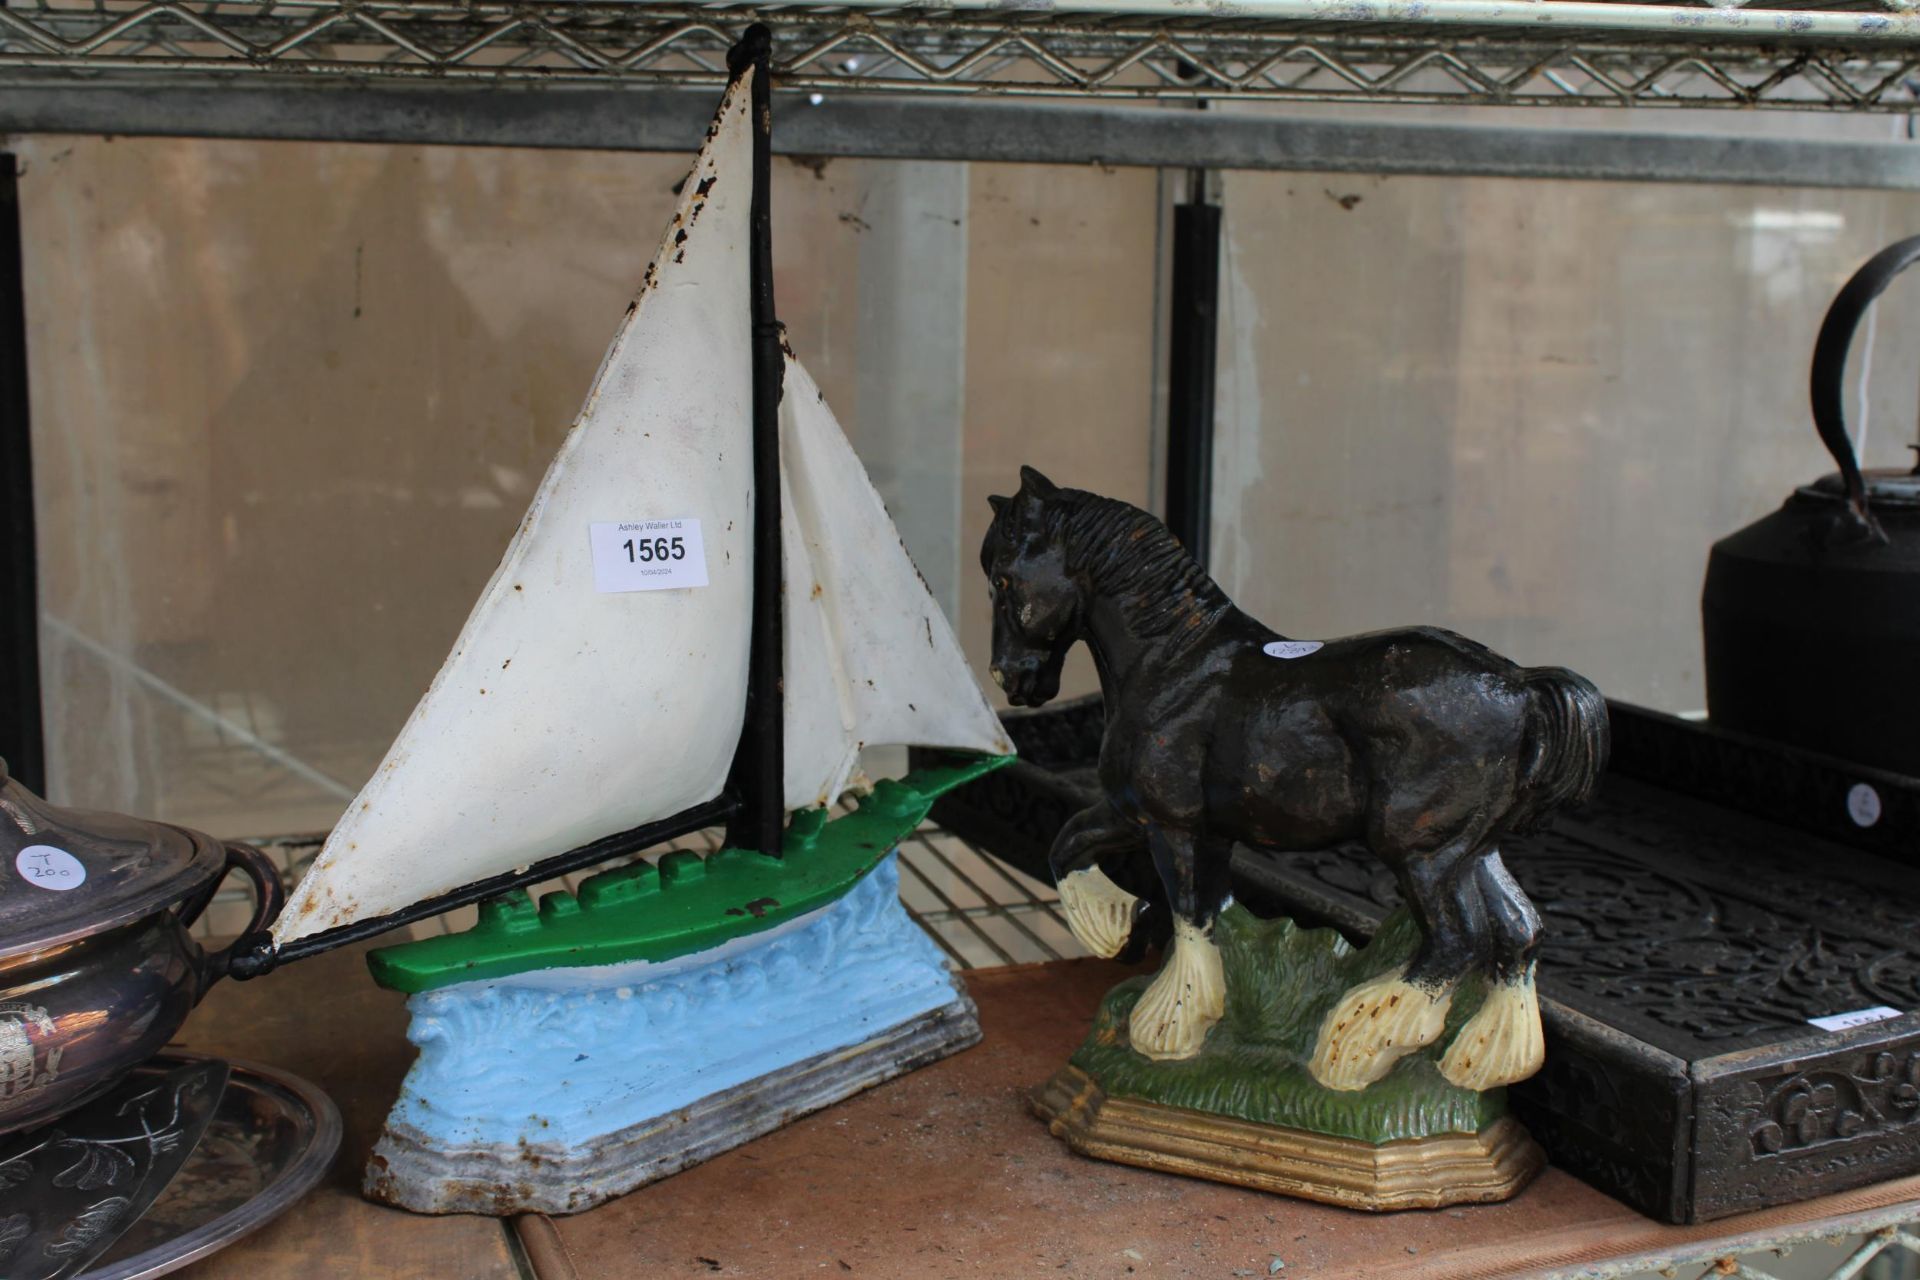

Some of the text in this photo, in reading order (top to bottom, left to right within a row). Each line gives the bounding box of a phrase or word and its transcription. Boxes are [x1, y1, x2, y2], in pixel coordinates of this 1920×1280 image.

[618, 520, 682, 532] Ashley Waller Ltd
[623, 536, 686, 563] 1565
